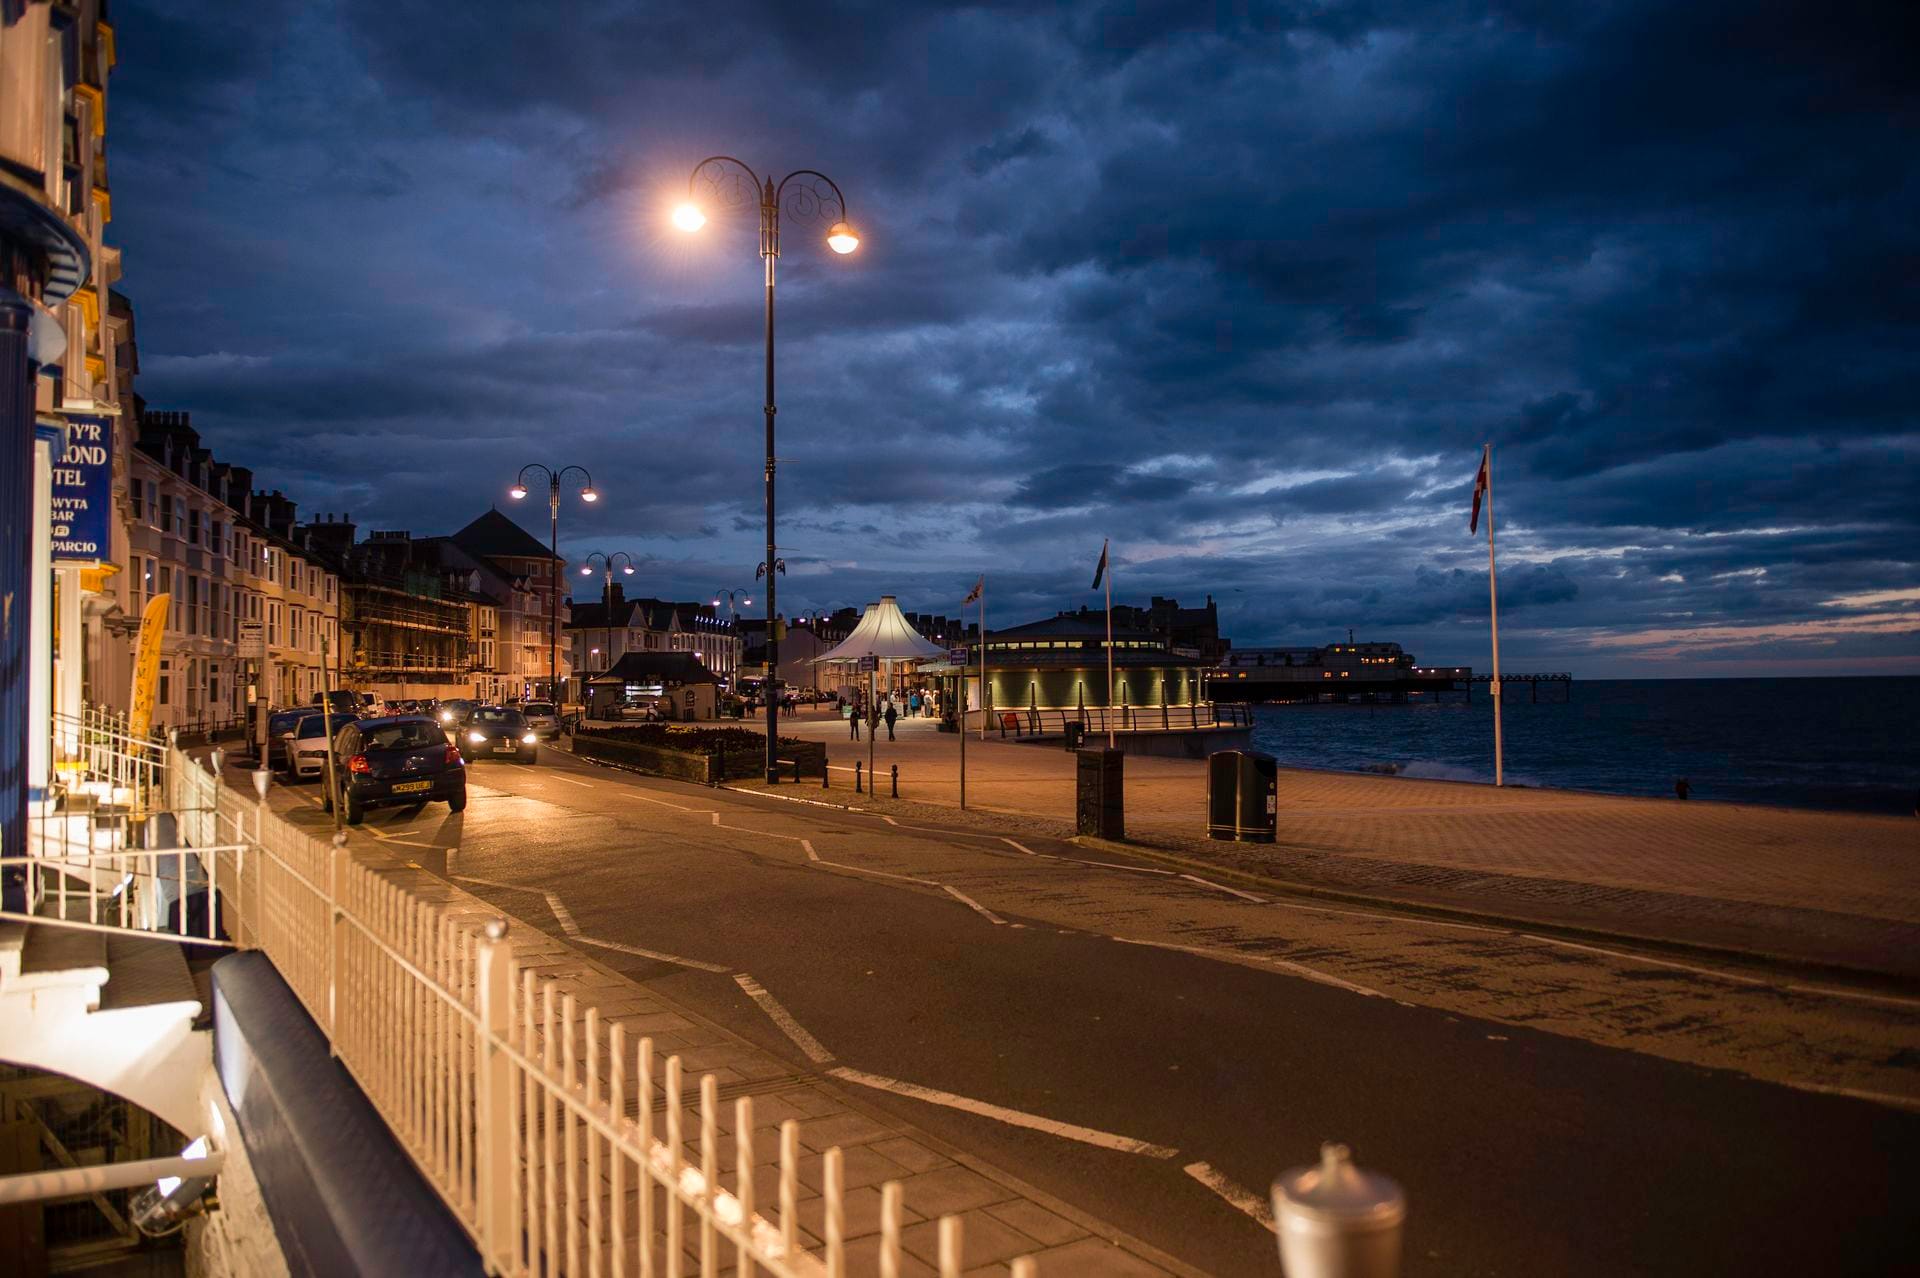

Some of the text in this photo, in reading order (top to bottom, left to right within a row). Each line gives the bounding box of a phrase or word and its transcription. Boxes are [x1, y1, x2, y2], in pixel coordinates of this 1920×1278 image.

[67, 423, 102, 441] TY'R
[58, 445, 107, 465] OND
[52, 469, 86, 486] TEL
[50, 498, 88, 510] WYTA
[51, 541, 97, 552] PARCIO
